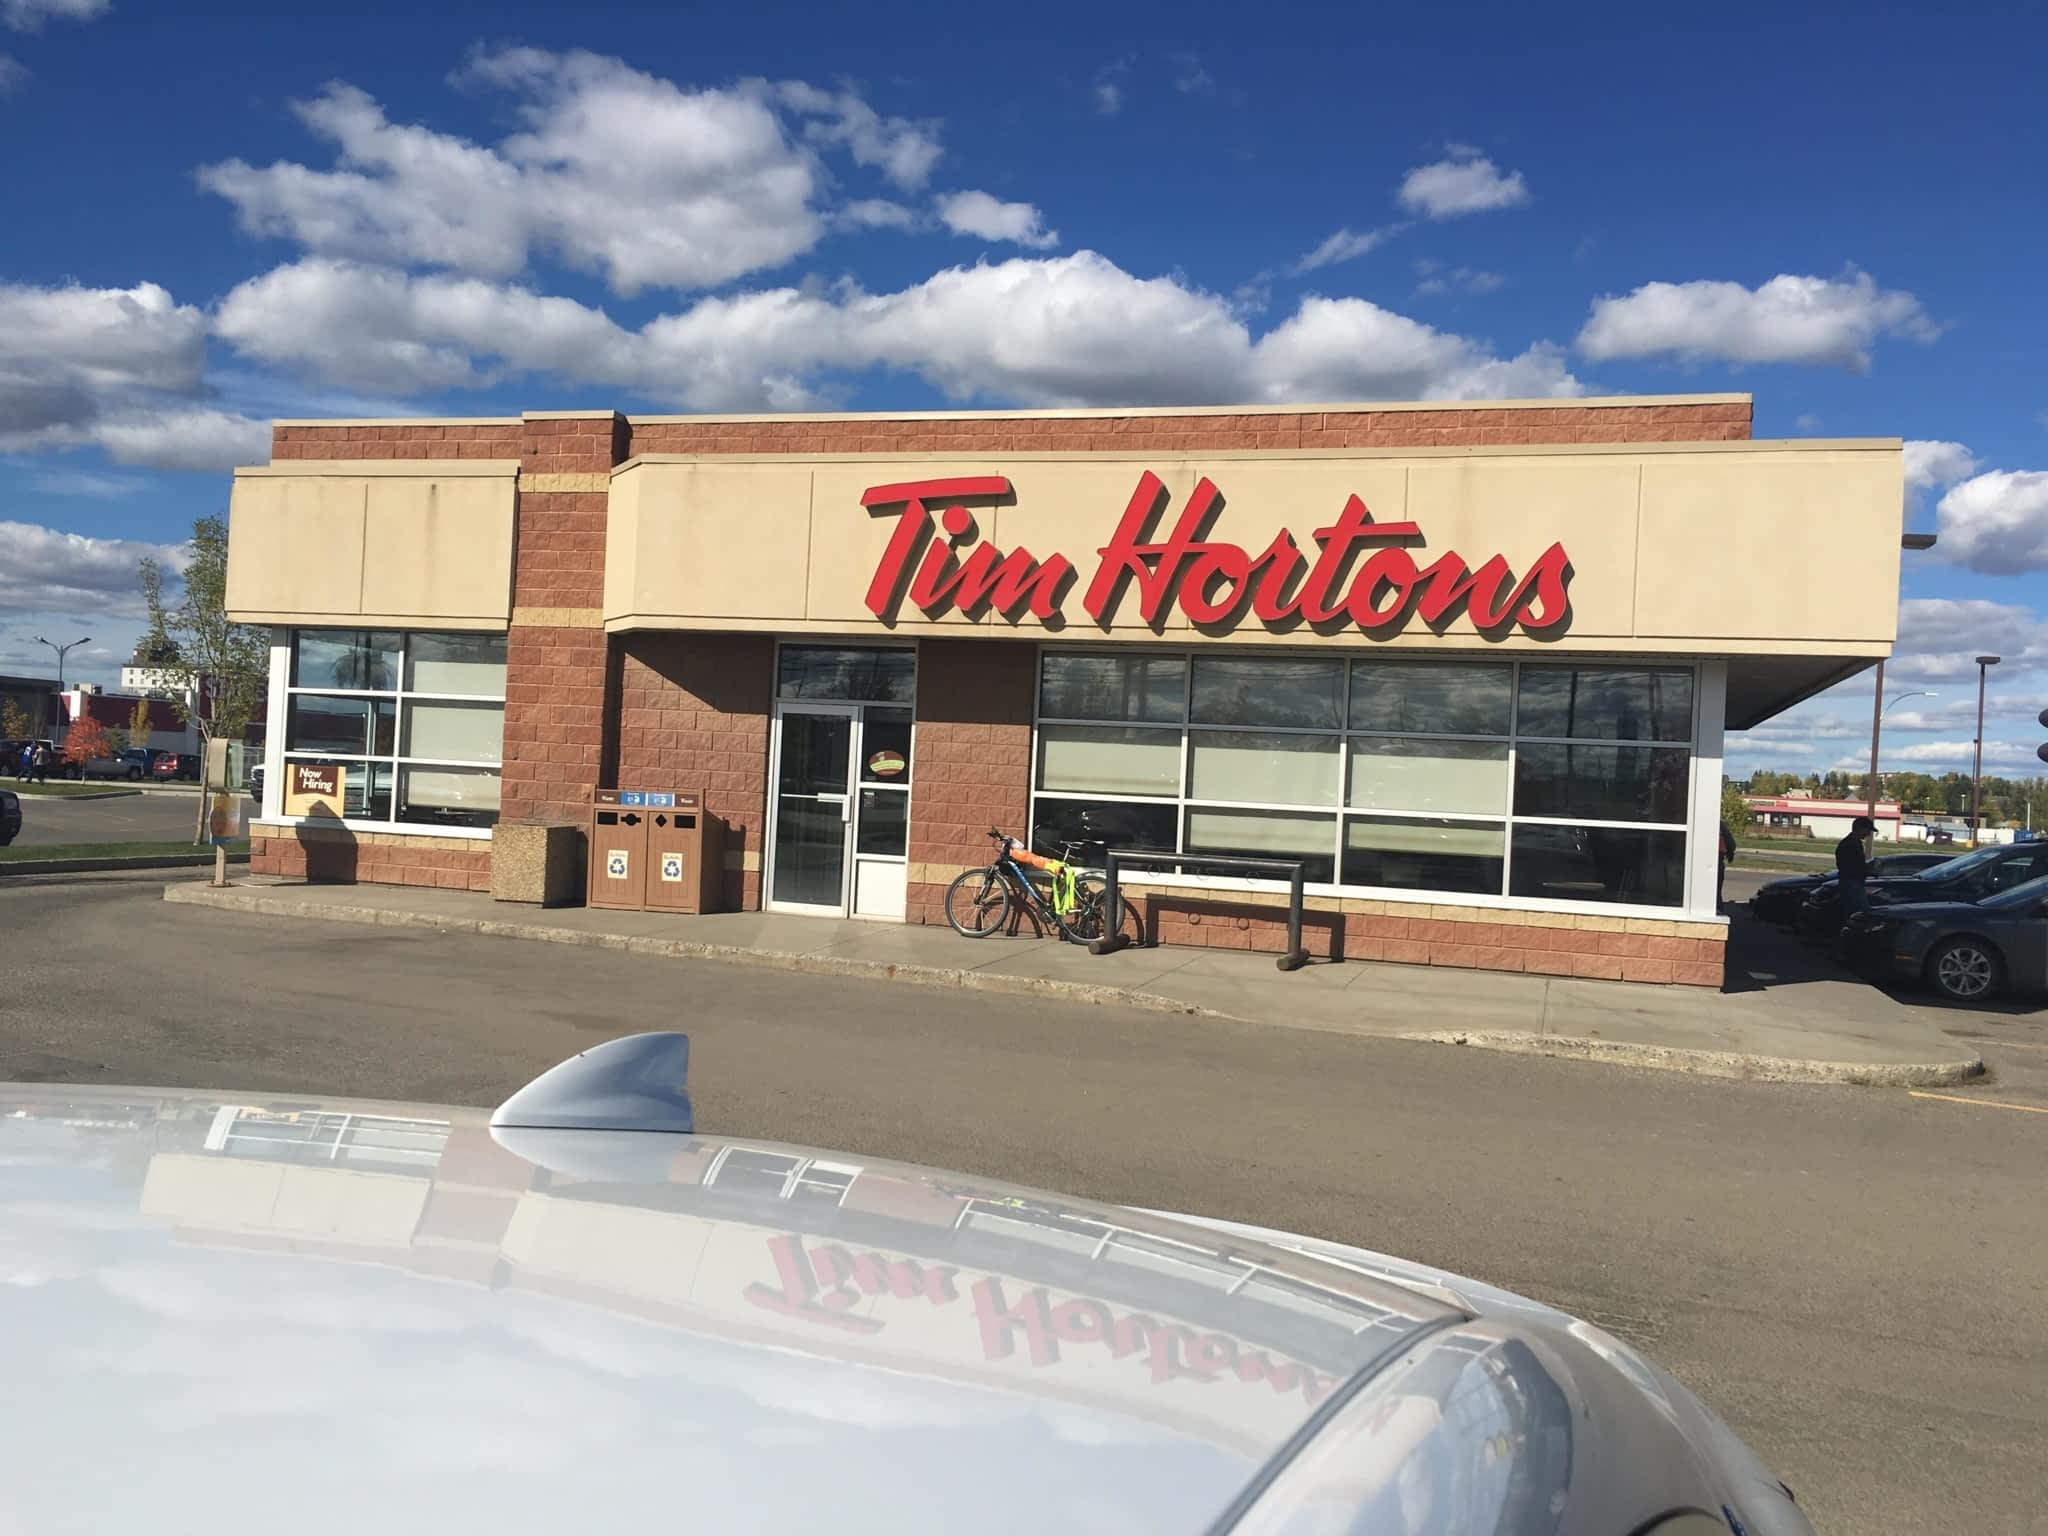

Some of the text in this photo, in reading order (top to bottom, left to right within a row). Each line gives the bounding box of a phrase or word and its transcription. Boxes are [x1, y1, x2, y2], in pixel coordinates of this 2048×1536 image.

[860, 471, 1568, 628] Tim Hortons
[299, 767, 322, 779] Now
[302, 778, 334, 793] Hiring
